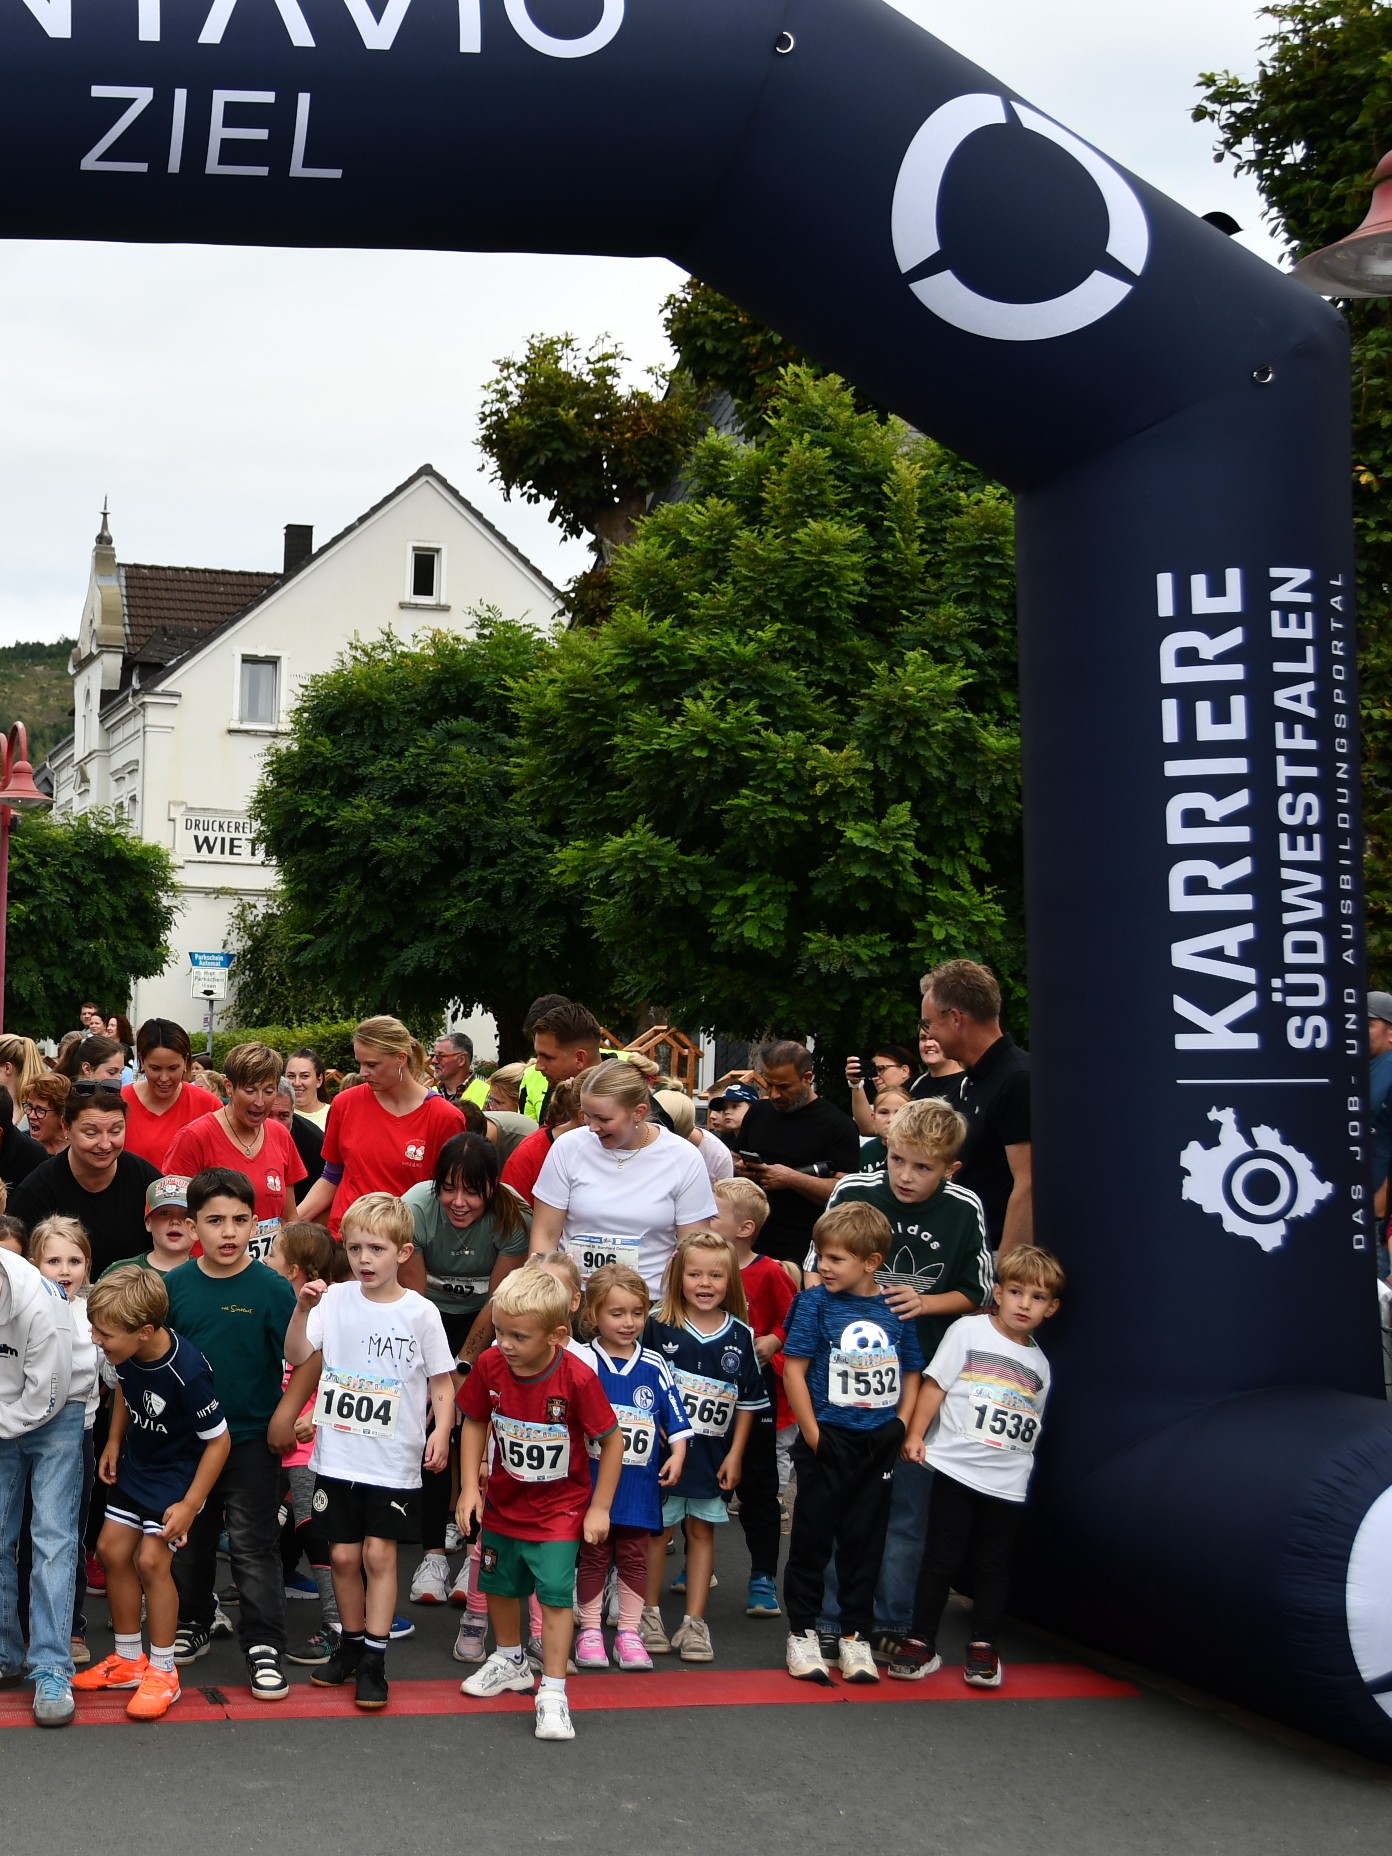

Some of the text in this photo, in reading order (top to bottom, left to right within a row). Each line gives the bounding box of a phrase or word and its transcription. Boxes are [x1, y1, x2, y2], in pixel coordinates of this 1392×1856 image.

[79, 85, 343, 180] ZIEL
[1156, 567, 1259, 1050] KARRIERE
[1268, 567, 1328, 1050] SÜDWESTFALEN
[185, 818, 253, 835] DRUCKEREI
[1329, 573, 1365, 1250] DAS JOB- UND AUSBILDUNGSPORTAL
[194, 953, 224, 961] Parkschein
[248, 1235, 278, 1260] 57
[891, 1221, 941, 1251] idas
[583, 1251, 617, 1268] 906
[443, 1283, 475, 1297] 907
[368, 1336, 417, 1363] MATS
[836, 1367, 897, 1396] 1532
[323, 1388, 392, 1426] 1604
[682, 1393, 729, 1426] 565
[974, 1403, 1038, 1443] 1538
[498, 1436, 564, 1470] 1597
